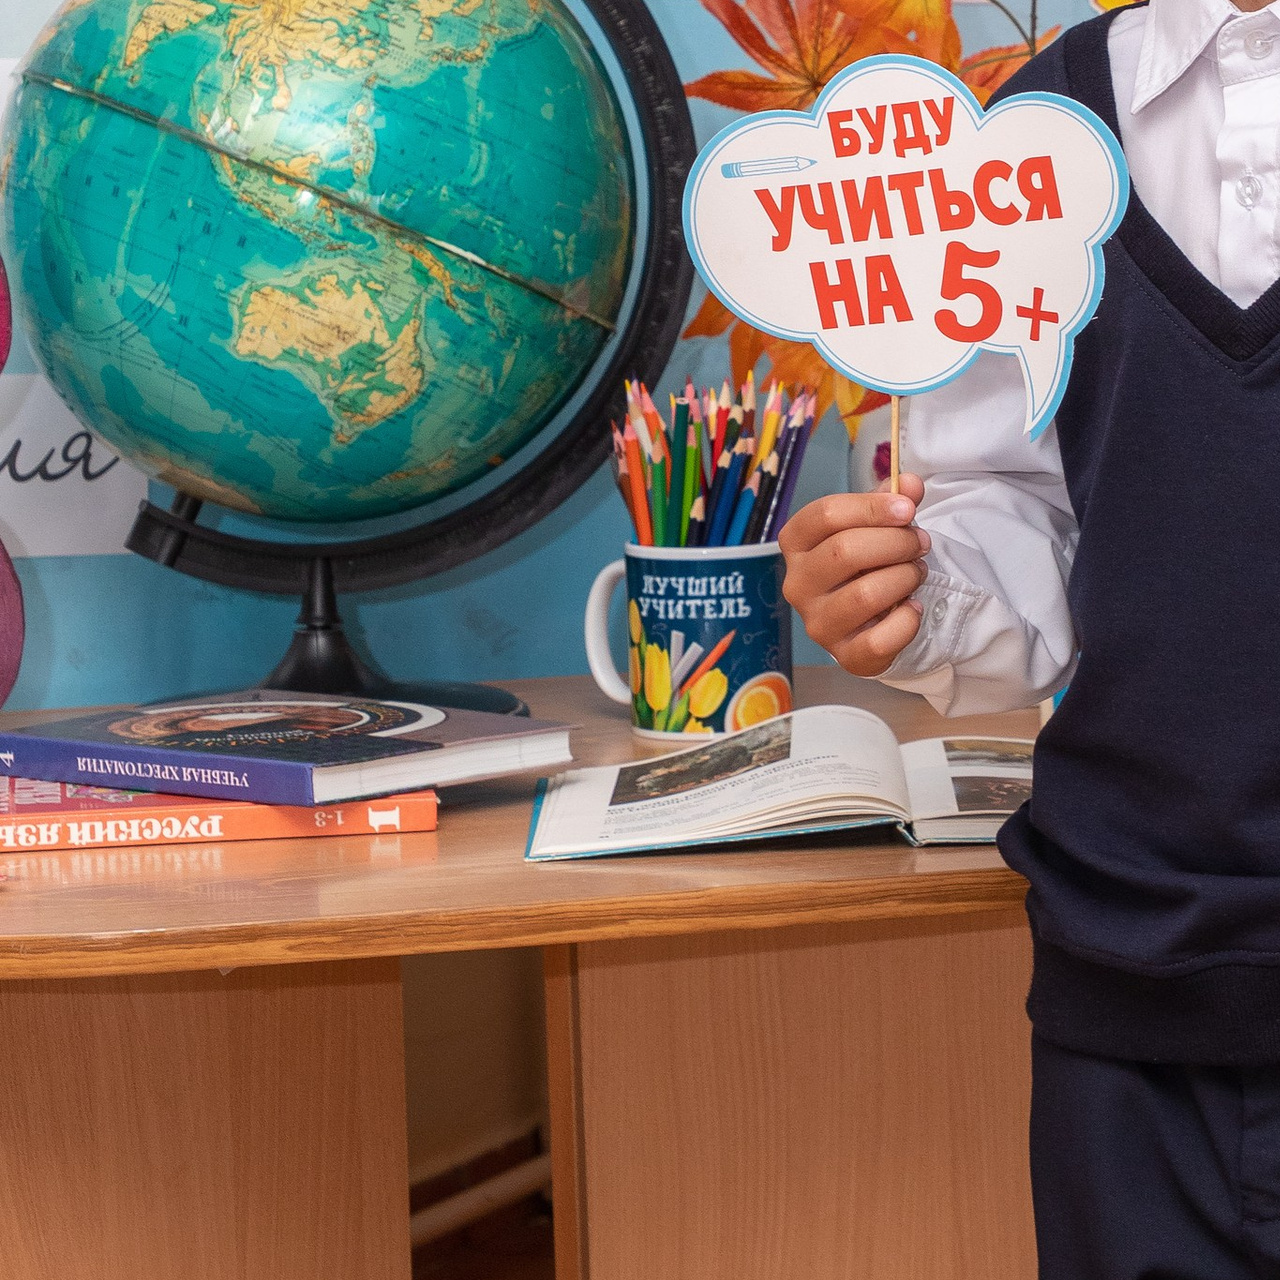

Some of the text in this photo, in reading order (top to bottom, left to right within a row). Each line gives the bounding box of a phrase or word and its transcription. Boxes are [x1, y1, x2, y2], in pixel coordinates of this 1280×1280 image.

[826, 96, 955, 159] БУДУ
[753, 155, 1064, 252] УЧИТЬСЯ
[808, 254, 914, 331] НА
[642, 571, 745, 596] ЛУЧШИЙ
[638, 596, 752, 620] УЧИТЕЛЬ
[76, 756, 180, 781] ХРЕСТОМАТИЯ
[182, 766, 250, 787] УЧЕБНАЯ
[67, 815, 224, 846] РУССКИЙ
[314, 809, 344, 828] 1-3
